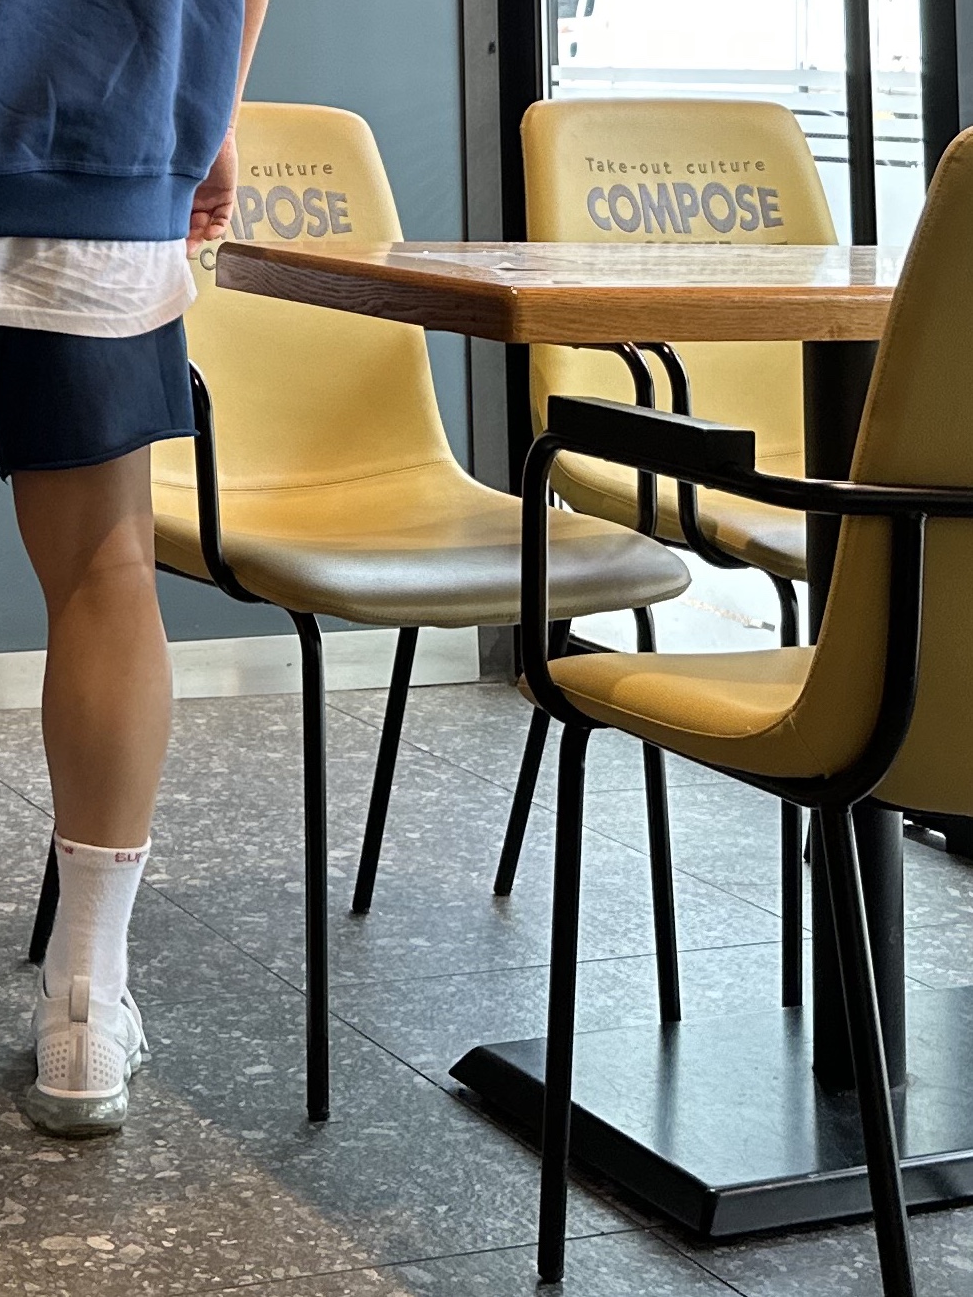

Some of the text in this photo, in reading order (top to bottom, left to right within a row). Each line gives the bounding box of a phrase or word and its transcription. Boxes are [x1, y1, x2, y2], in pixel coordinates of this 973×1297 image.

[251, 162, 334, 178] culture
[585, 157, 766, 175] Take-out culture
[586, 181, 784, 235] COMPOSE
